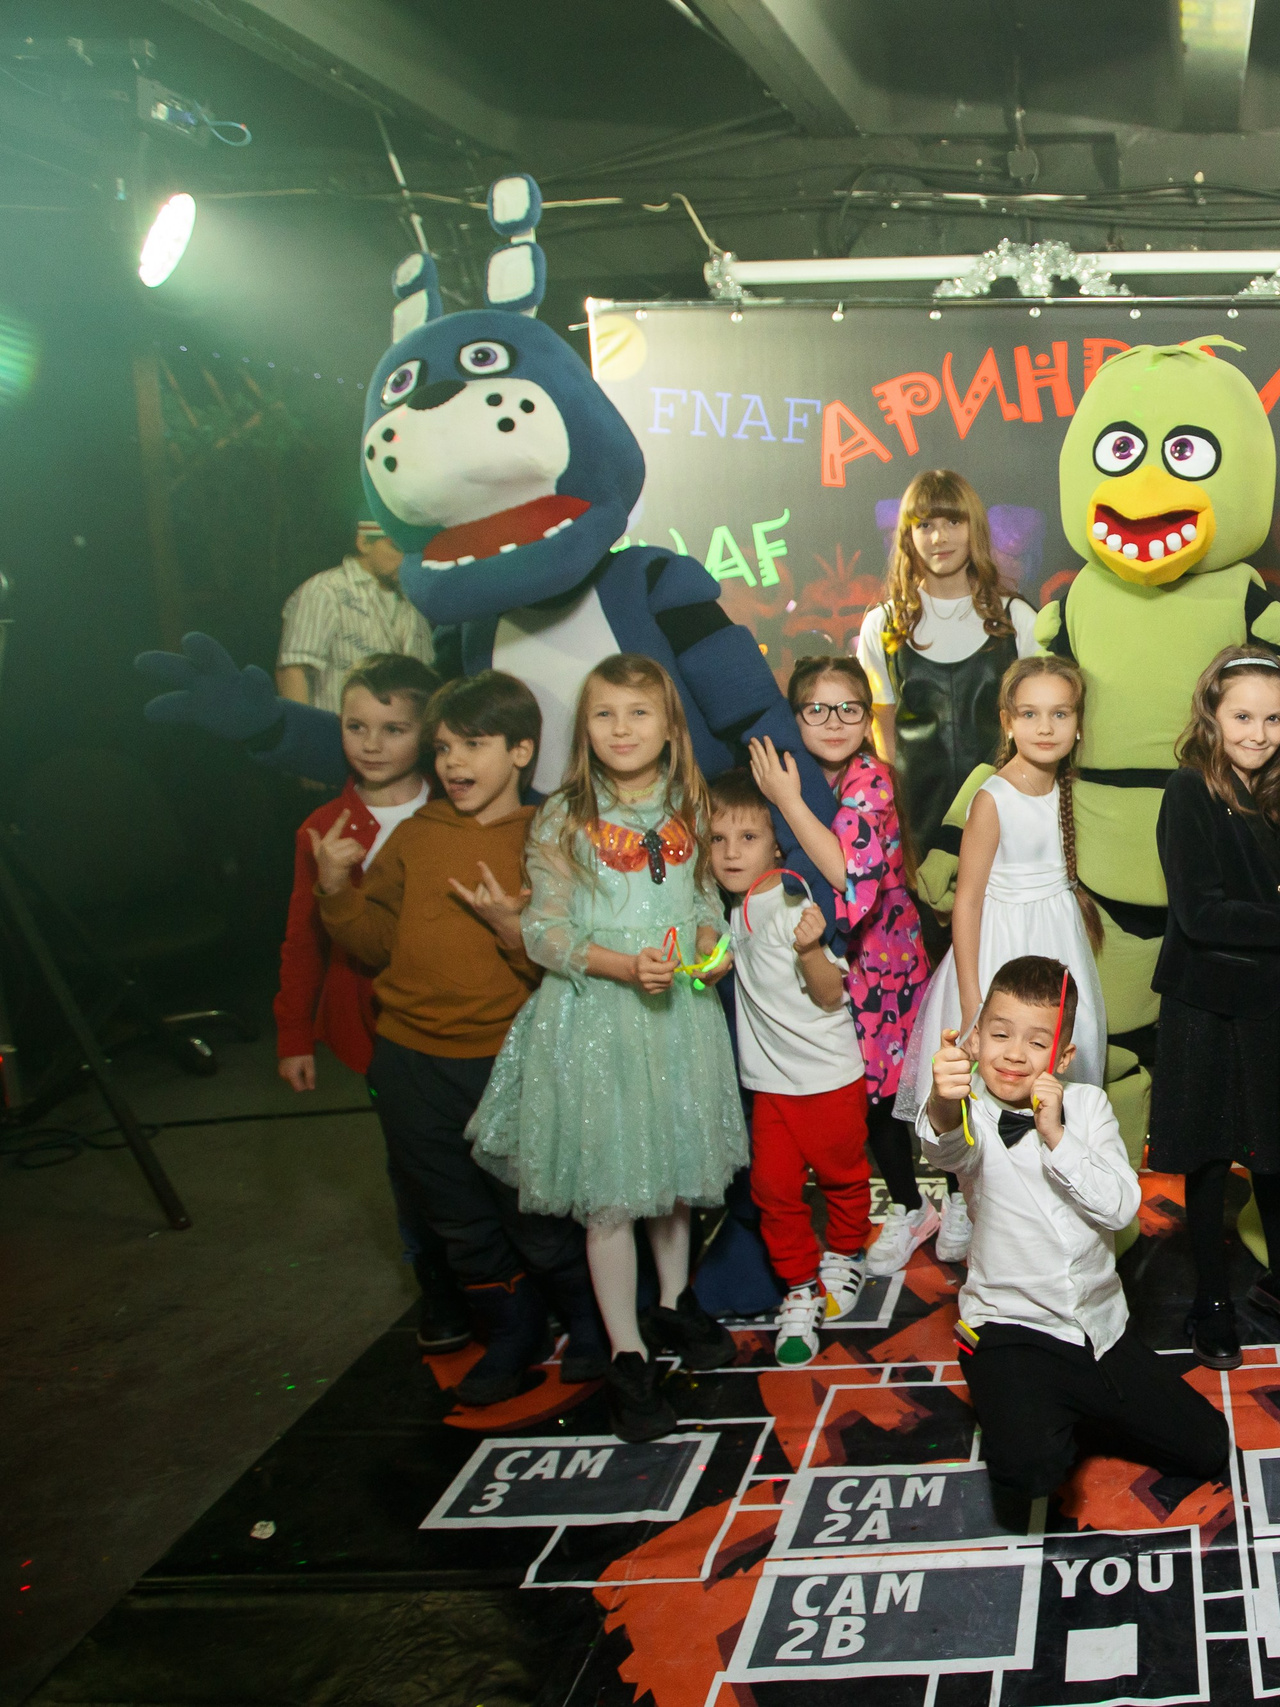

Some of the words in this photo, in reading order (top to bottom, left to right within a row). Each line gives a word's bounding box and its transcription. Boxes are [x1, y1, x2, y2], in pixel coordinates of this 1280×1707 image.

[647, 386, 821, 444] FNAF
[609, 507, 791, 588] AF
[493, 1448, 614, 1481] CAM
[469, 1482, 504, 1513] 3
[826, 1475, 946, 1511] CAM
[812, 1513, 891, 1544] 2A
[790, 1572, 925, 1618] CAM
[1052, 1554, 1174, 1598] YOU
[775, 1616, 866, 1661] 2B
